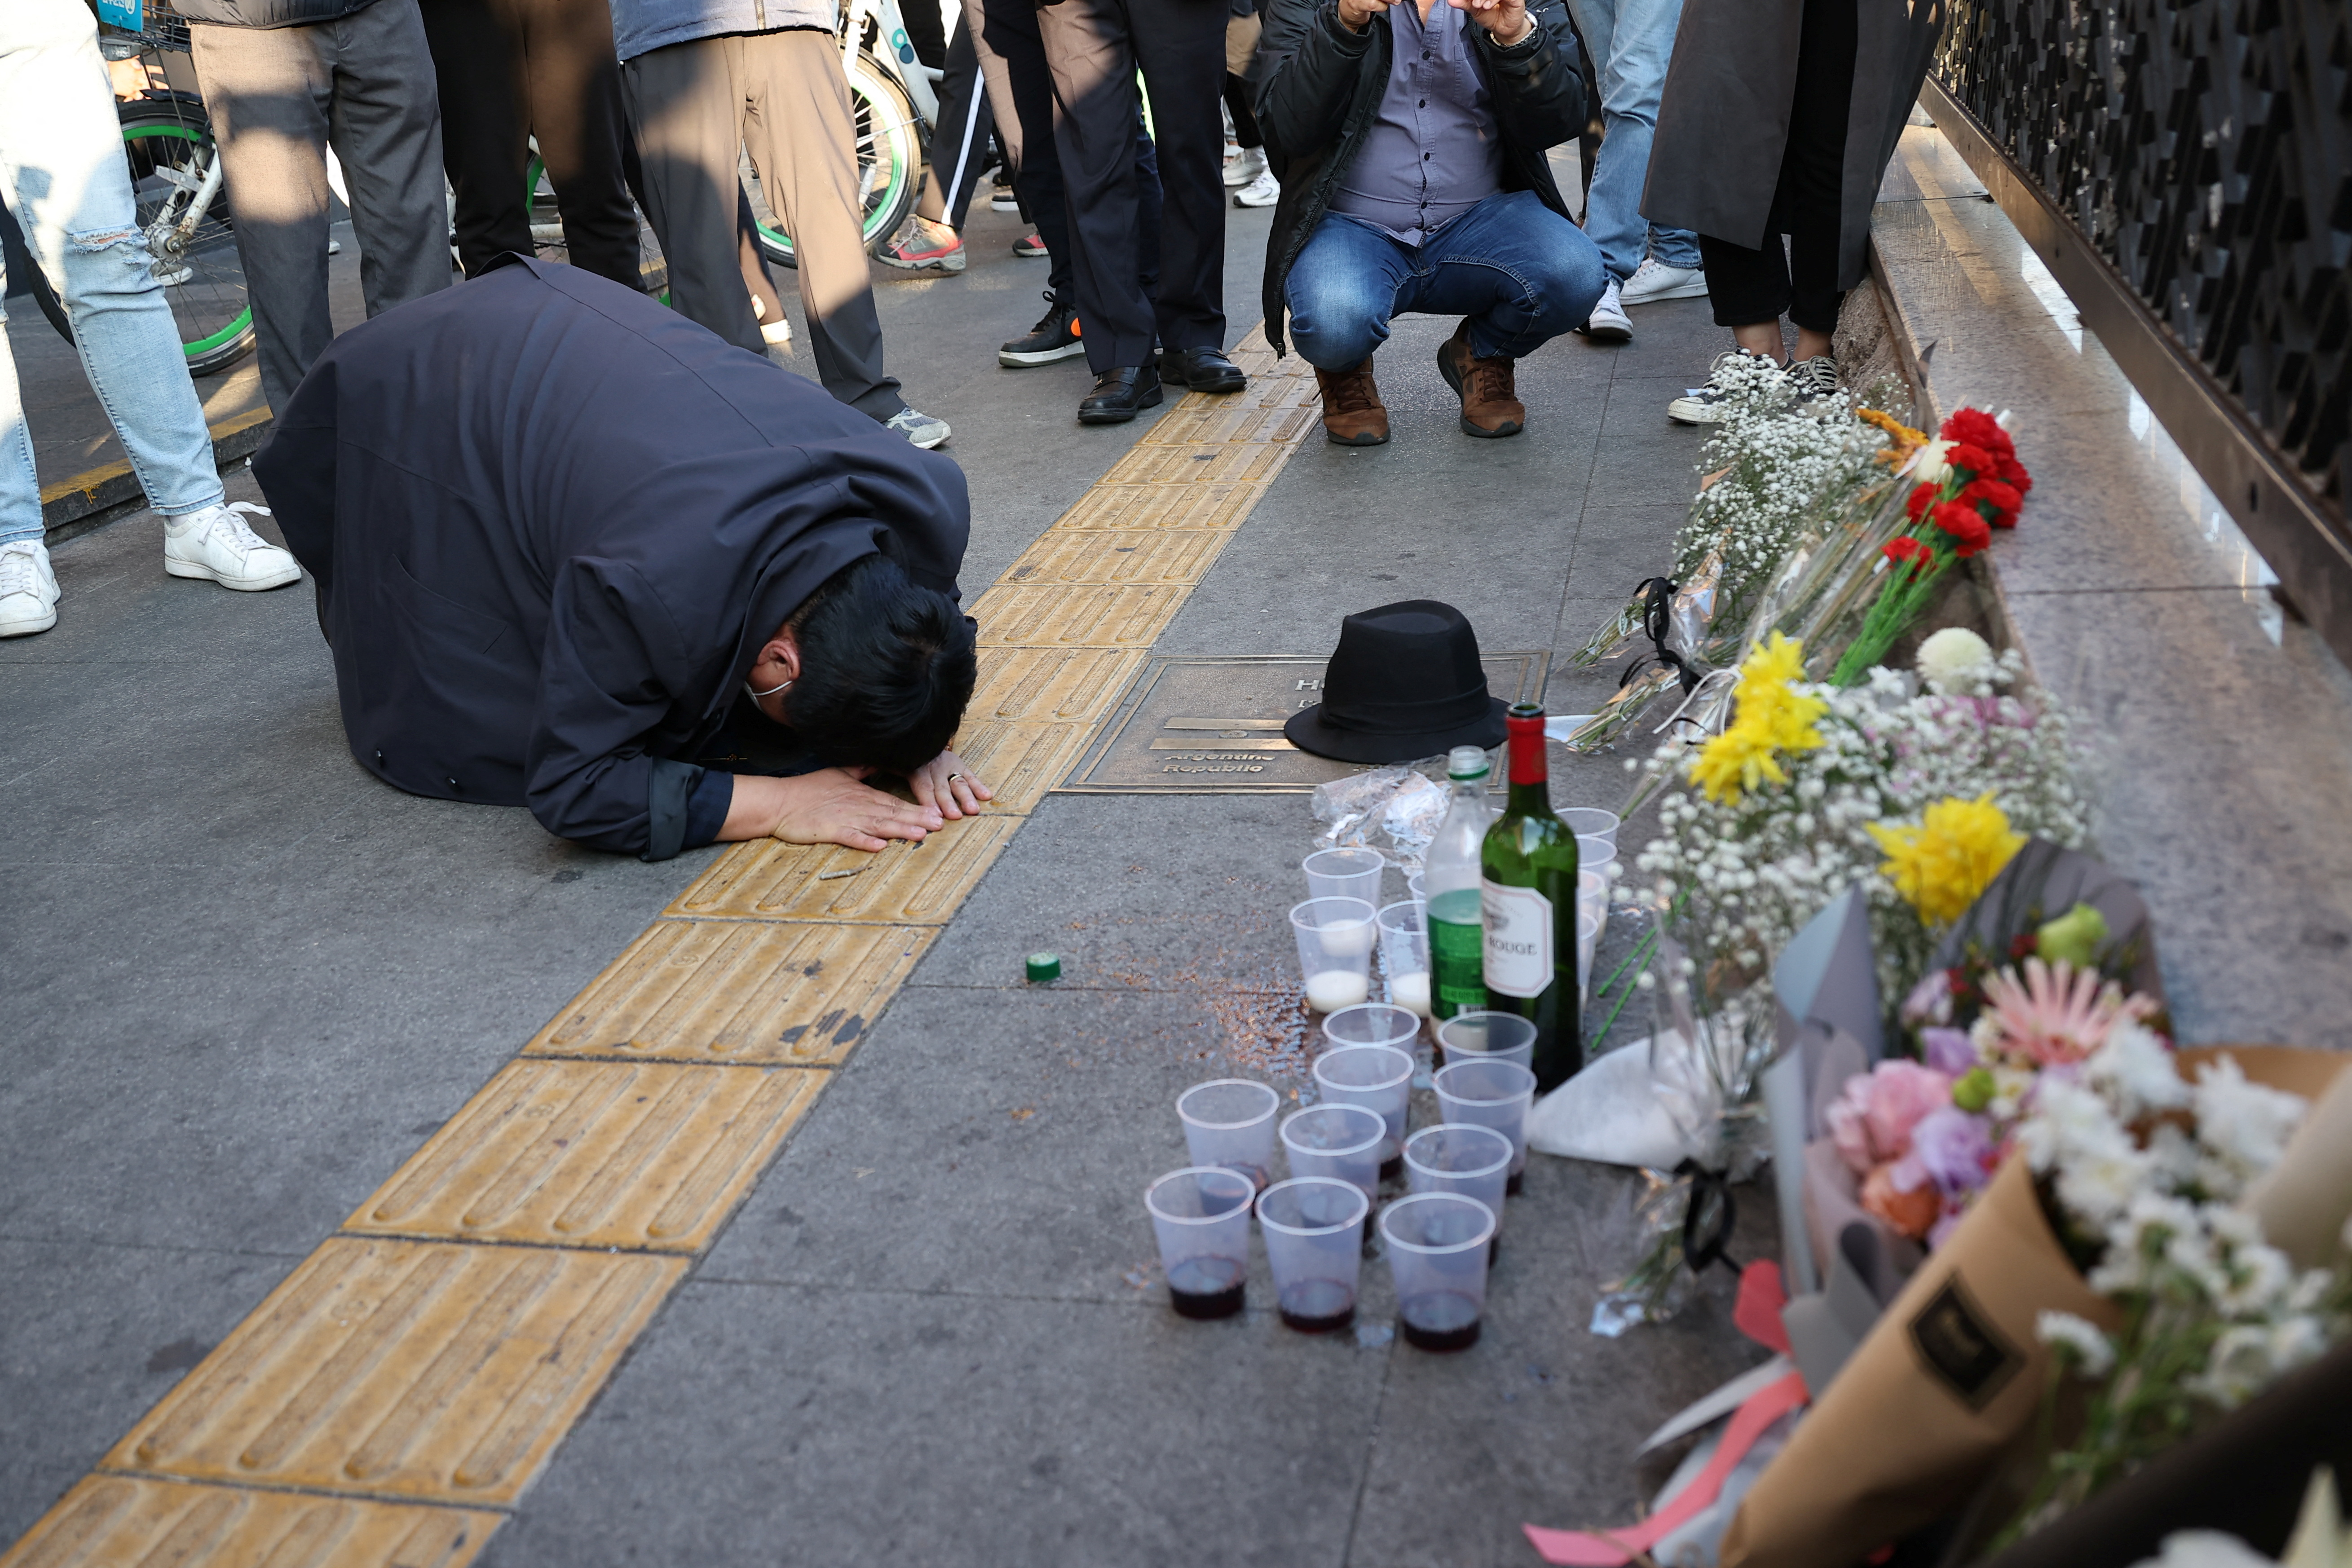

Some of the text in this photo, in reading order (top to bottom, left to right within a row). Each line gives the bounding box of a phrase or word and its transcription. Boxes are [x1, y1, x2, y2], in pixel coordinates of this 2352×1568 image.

[1295, 680, 1325, 690] H
[1162, 764, 1264, 773] Republic
[1489, 934, 1538, 956] ROUGE
